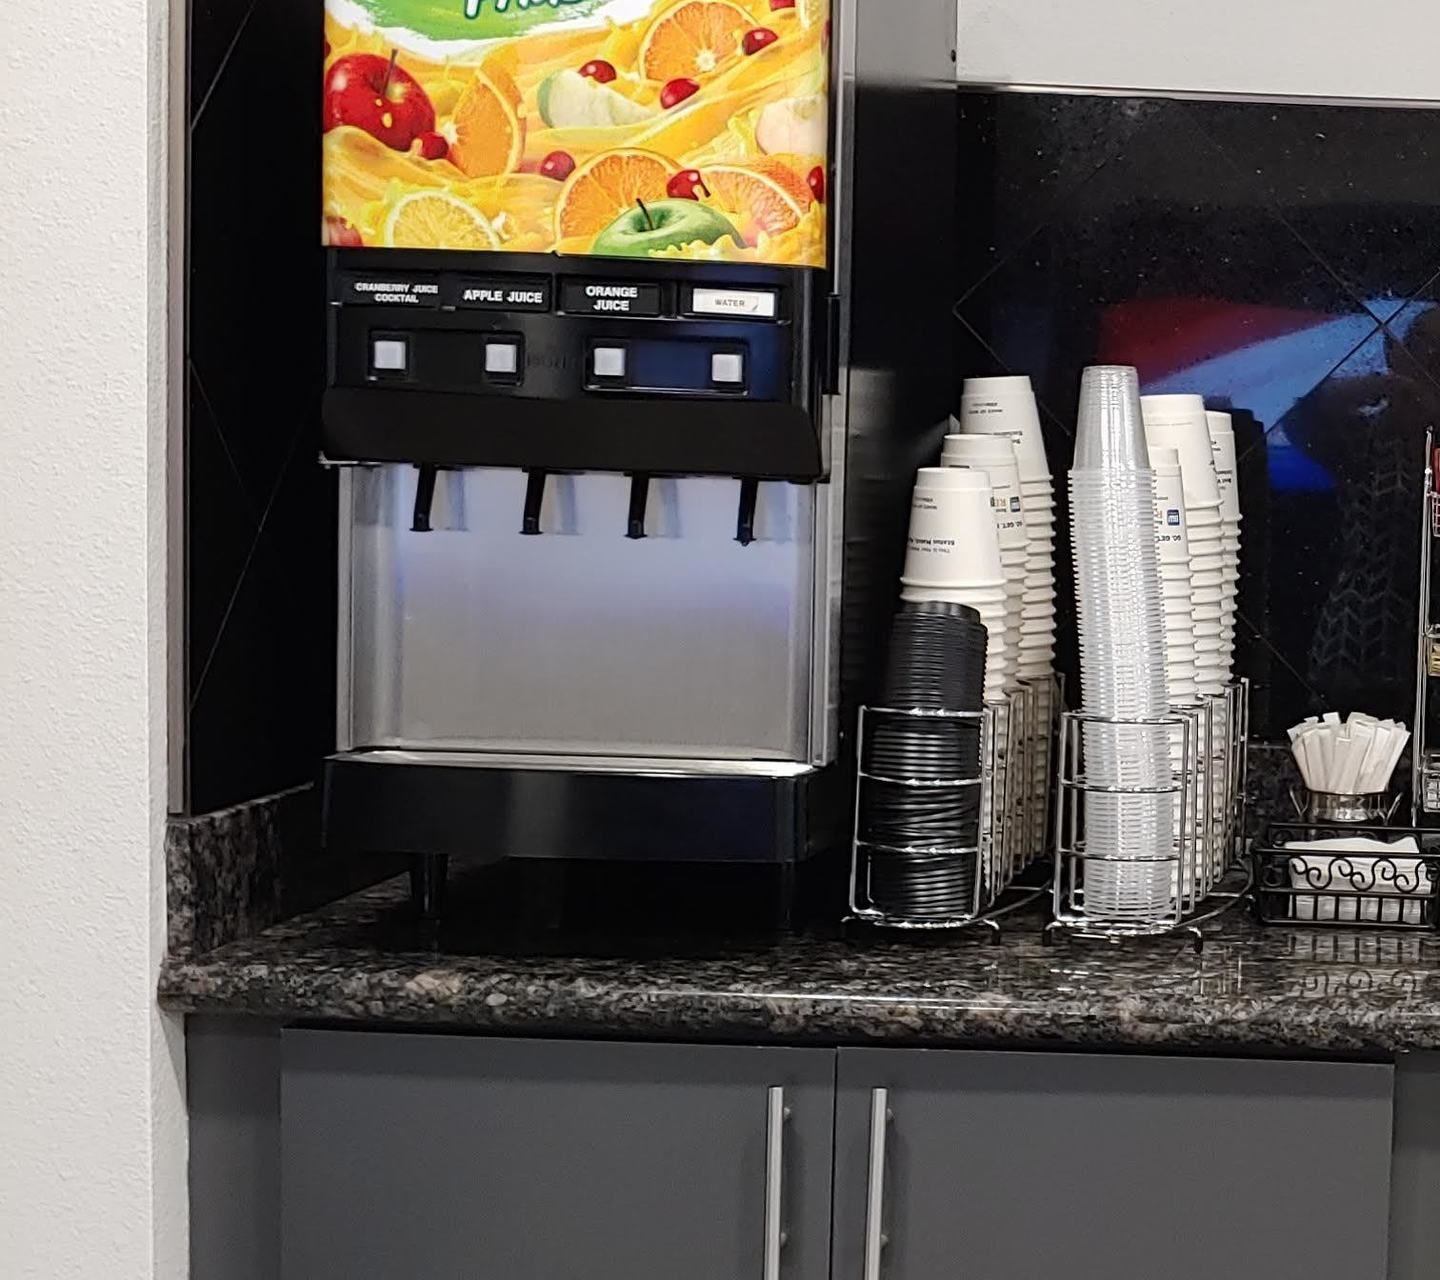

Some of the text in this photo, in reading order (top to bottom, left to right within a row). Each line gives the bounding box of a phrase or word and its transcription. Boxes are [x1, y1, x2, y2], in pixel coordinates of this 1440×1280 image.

[355, 282, 439, 294] CRANBERRY JUICE
[585, 285, 638, 298] ORANGE
[374, 293, 419, 303] COCKTAIL
[463, 289, 543, 303] APPLE JUICE
[593, 300, 630, 311] JUICE
[714, 298, 745, 307] WATER
